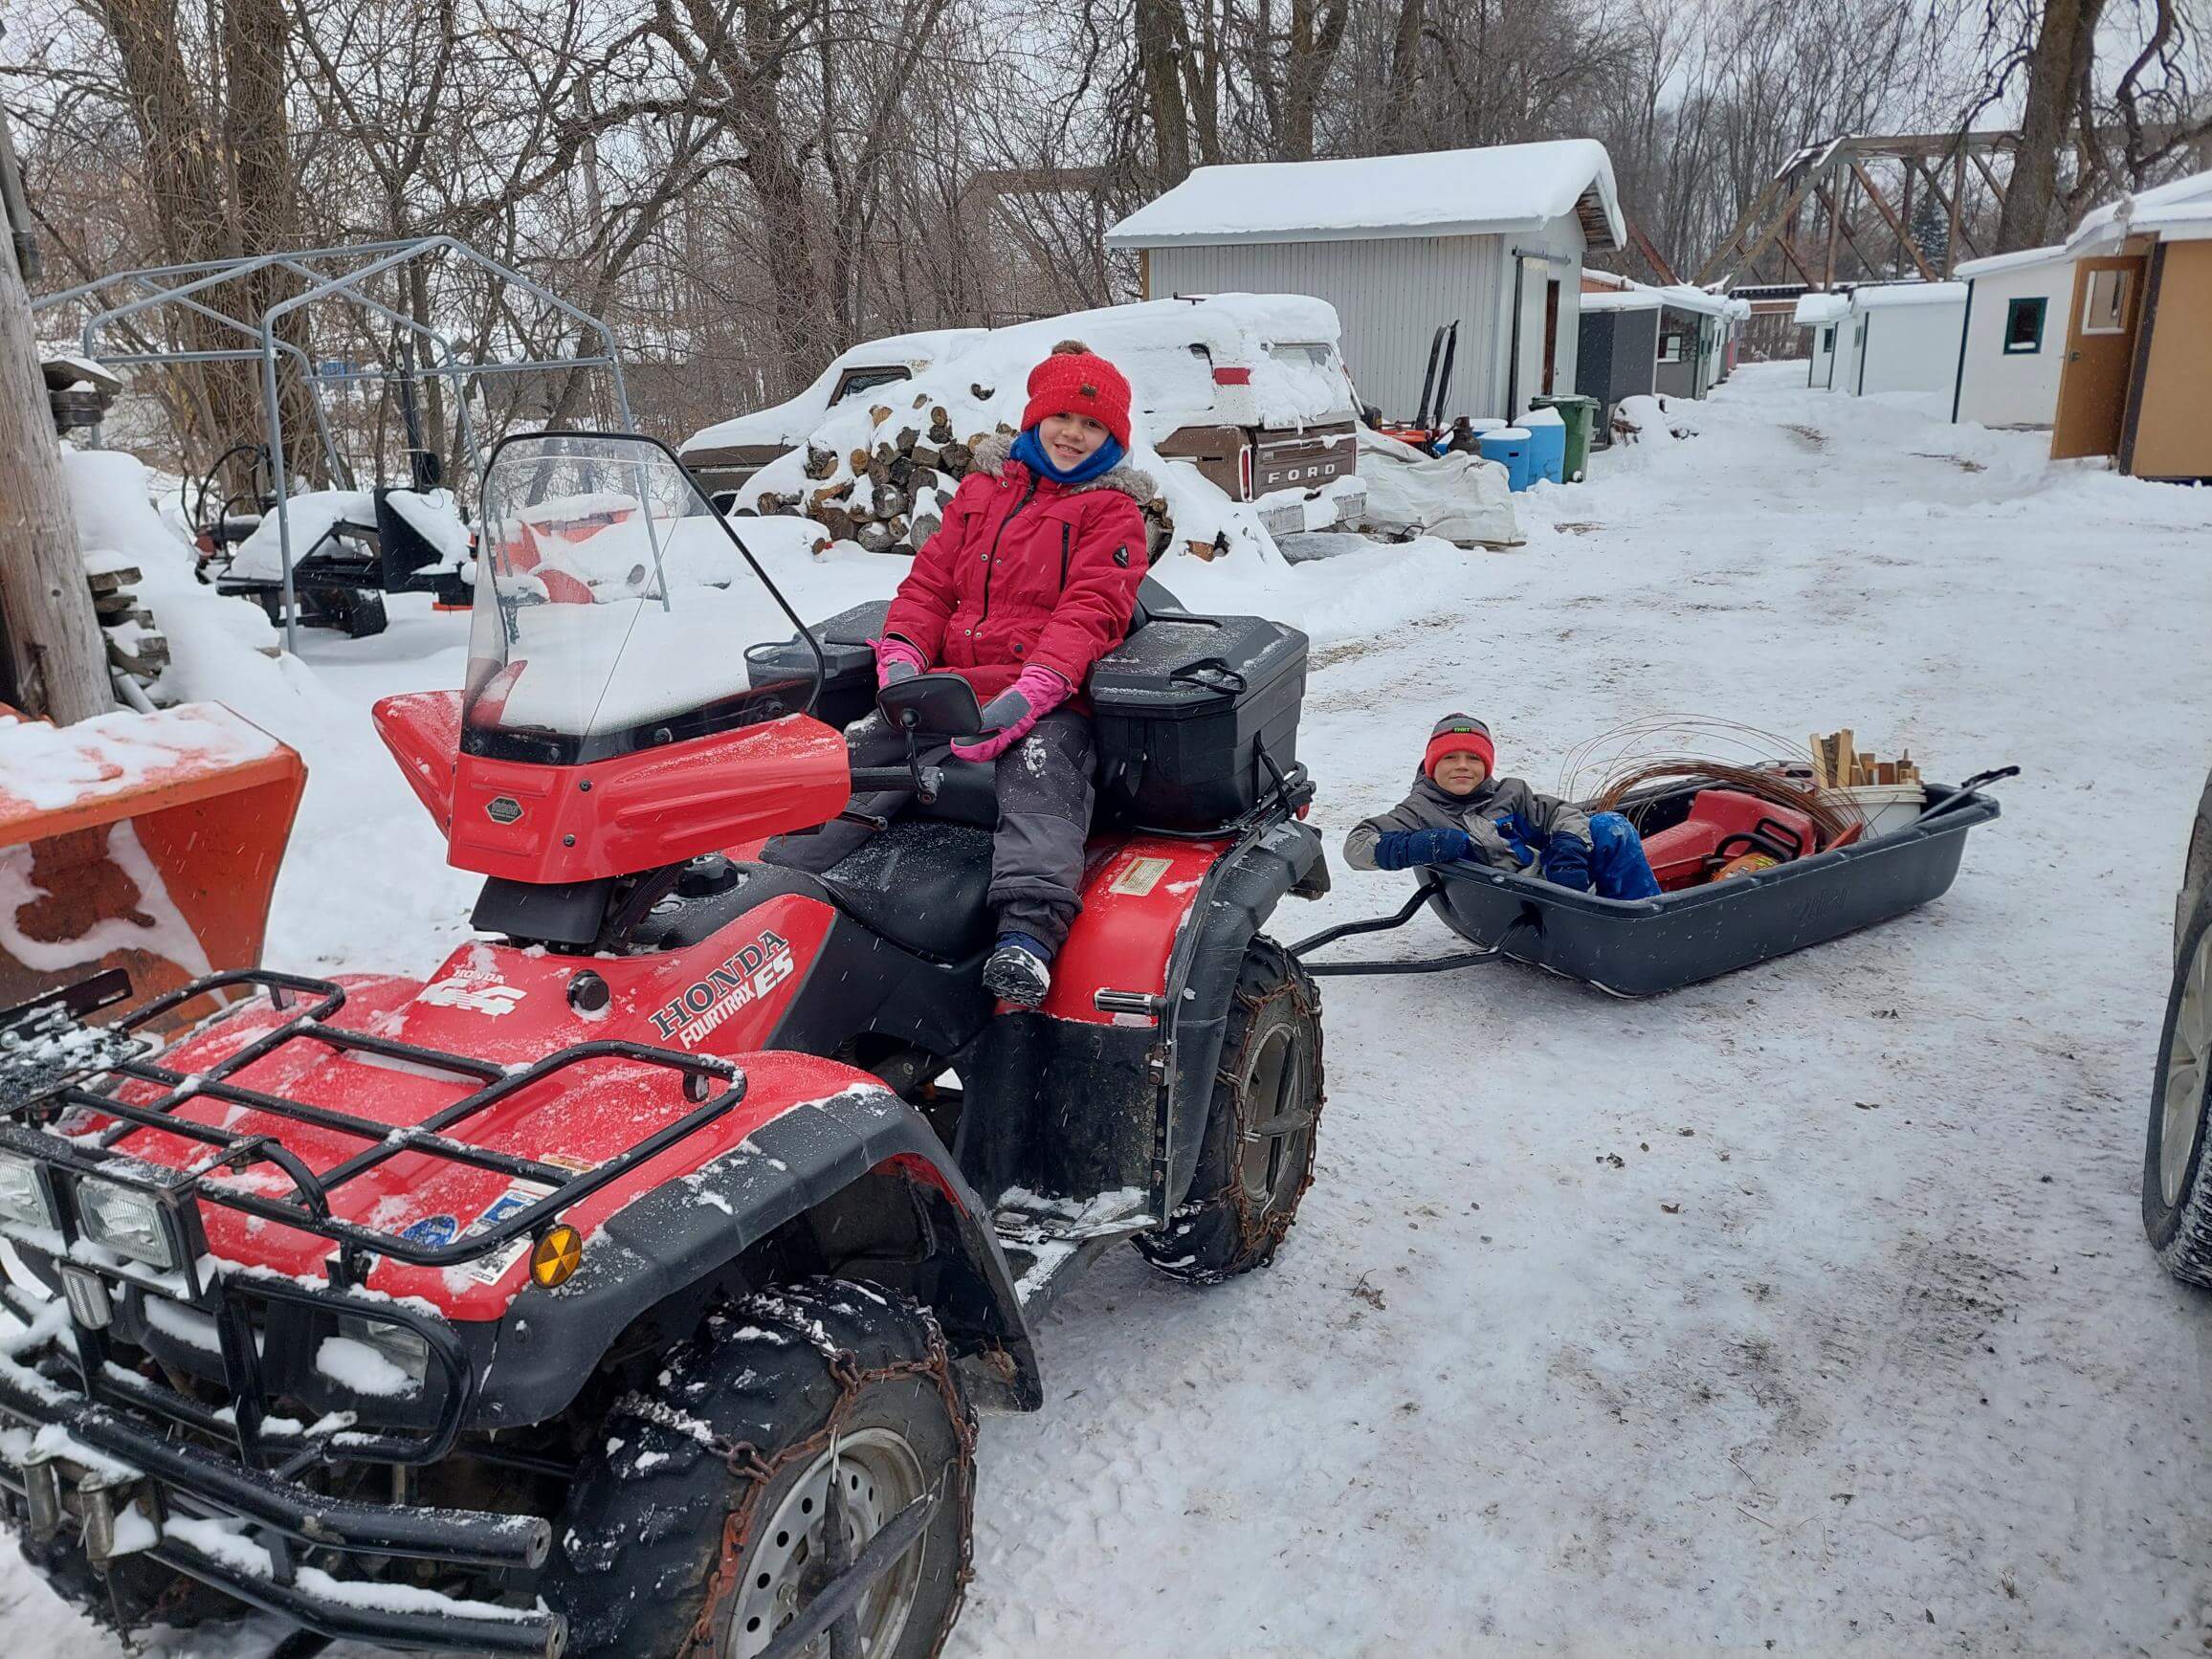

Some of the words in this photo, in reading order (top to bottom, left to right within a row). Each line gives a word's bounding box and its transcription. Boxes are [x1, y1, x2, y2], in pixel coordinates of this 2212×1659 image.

[1268, 464, 1336, 484] FORD
[452, 969, 506, 984] HONDA
[648, 929, 789, 1042] HONDA
[679, 981, 756, 1050] FOURTRAX
[753, 947, 794, 1000] ES
